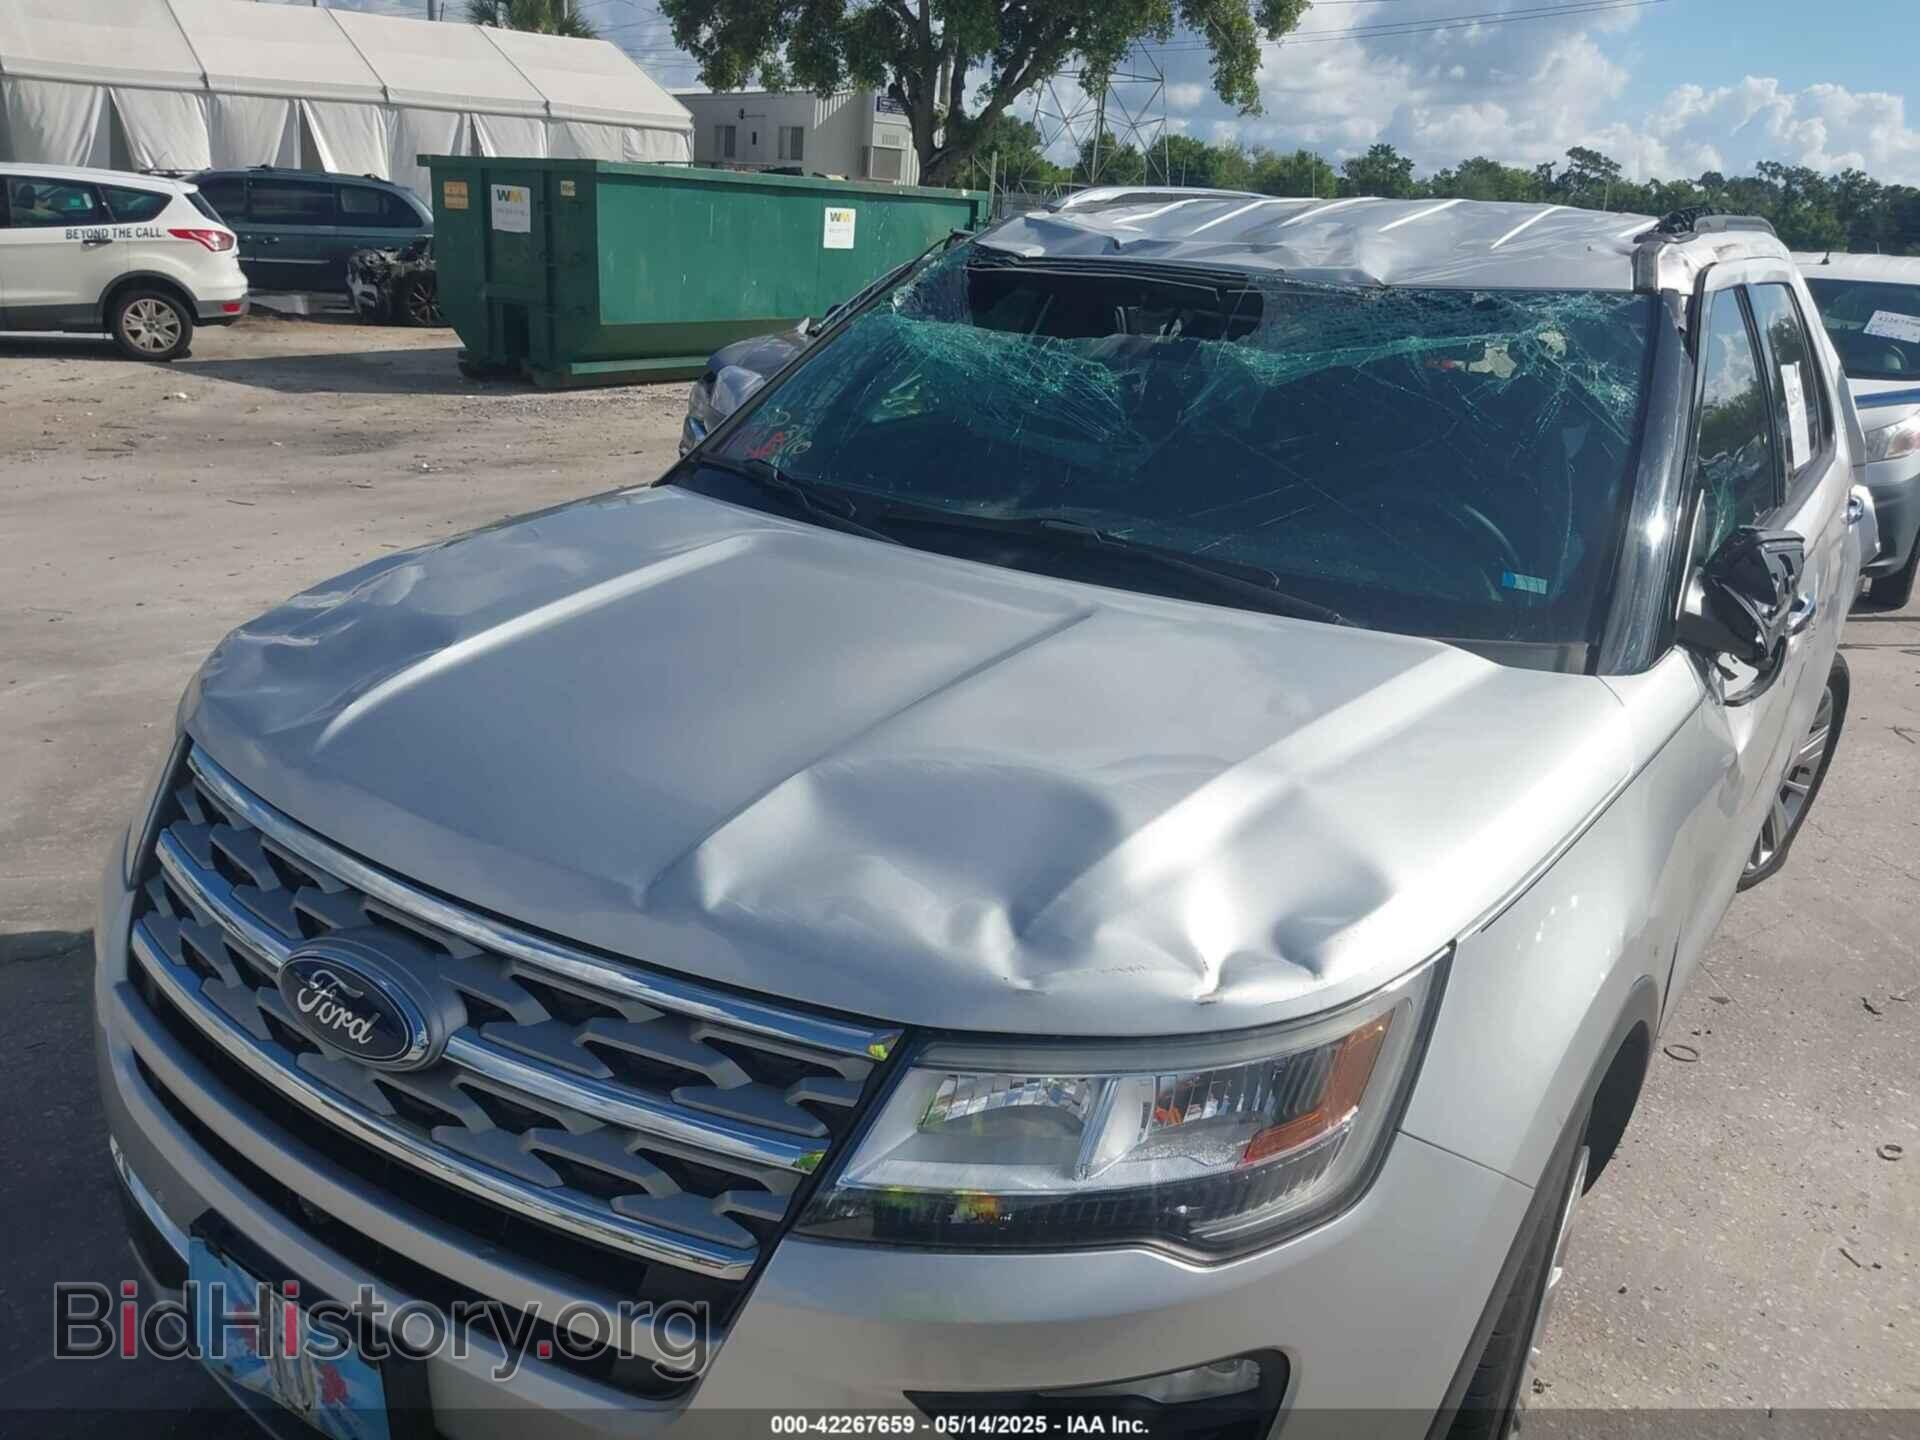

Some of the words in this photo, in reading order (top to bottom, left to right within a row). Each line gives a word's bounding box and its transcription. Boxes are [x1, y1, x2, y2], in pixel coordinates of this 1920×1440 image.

[65, 228, 109, 240] BEYOND
[112, 227, 133, 238] THE
[297, 969, 382, 1044] Ford
